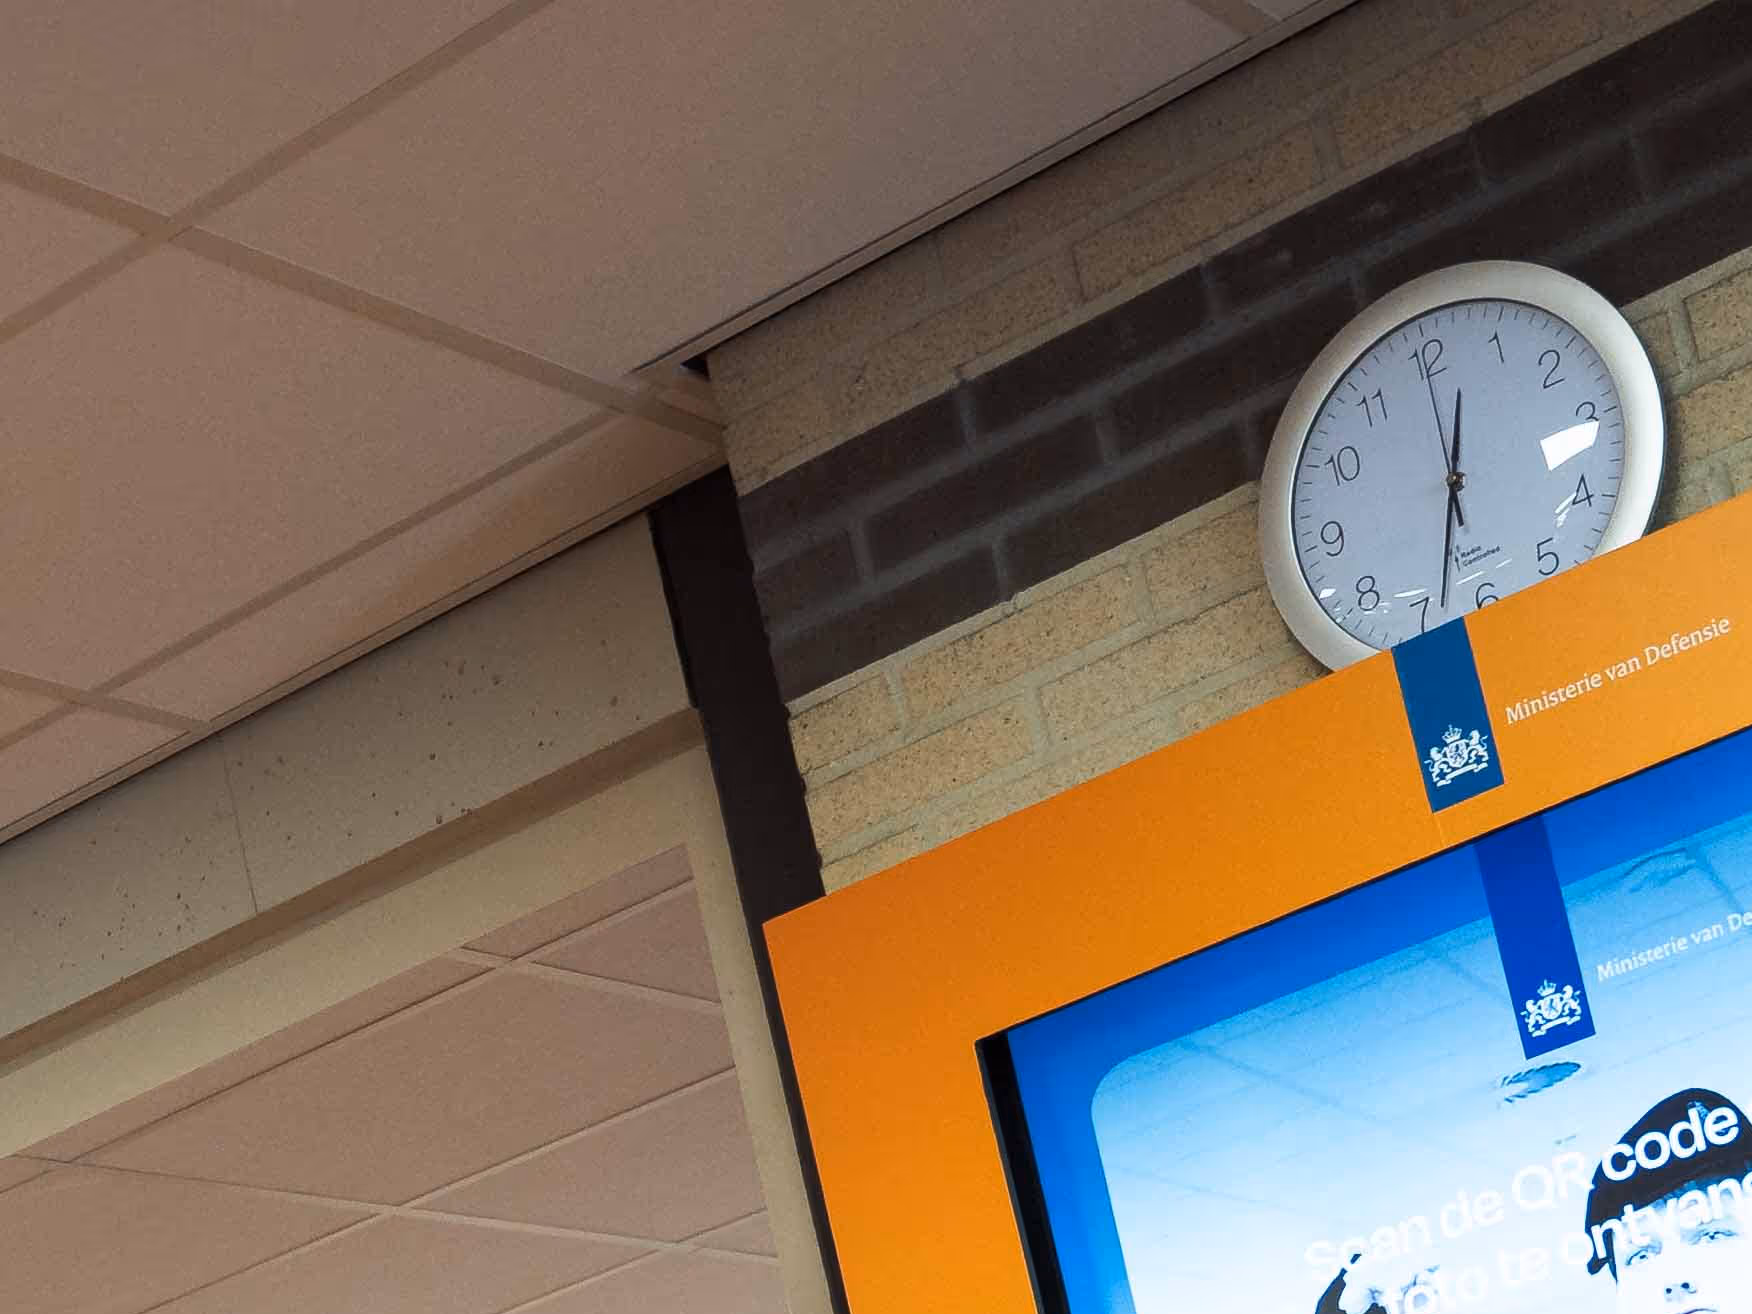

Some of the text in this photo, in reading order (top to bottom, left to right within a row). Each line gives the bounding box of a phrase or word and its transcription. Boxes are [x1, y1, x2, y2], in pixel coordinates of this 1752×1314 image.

[1407, 338, 1447, 382] 12
[1488, 330, 1505, 364] 1
[1537, 349, 1566, 390] 2
[1356, 387, 1388, 428] 11
[1324, 445, 1361, 487] 10
[1570, 473, 1595, 508] 4
[1319, 520, 1346, 558] 9
[1535, 537, 1560, 576] 5
[1355, 575, 1381, 613] 8
[1408, 596, 1432, 634] 7
[1505, 617, 1731, 724] Ministerie van Defensie
[1597, 934, 1689, 982] Ministerie
[1690, 921, 1725, 943] van
[1439, 1182, 1505, 1239] de
[1511, 1145, 1594, 1215] QR
[1600, 1103, 1742, 1182] code
